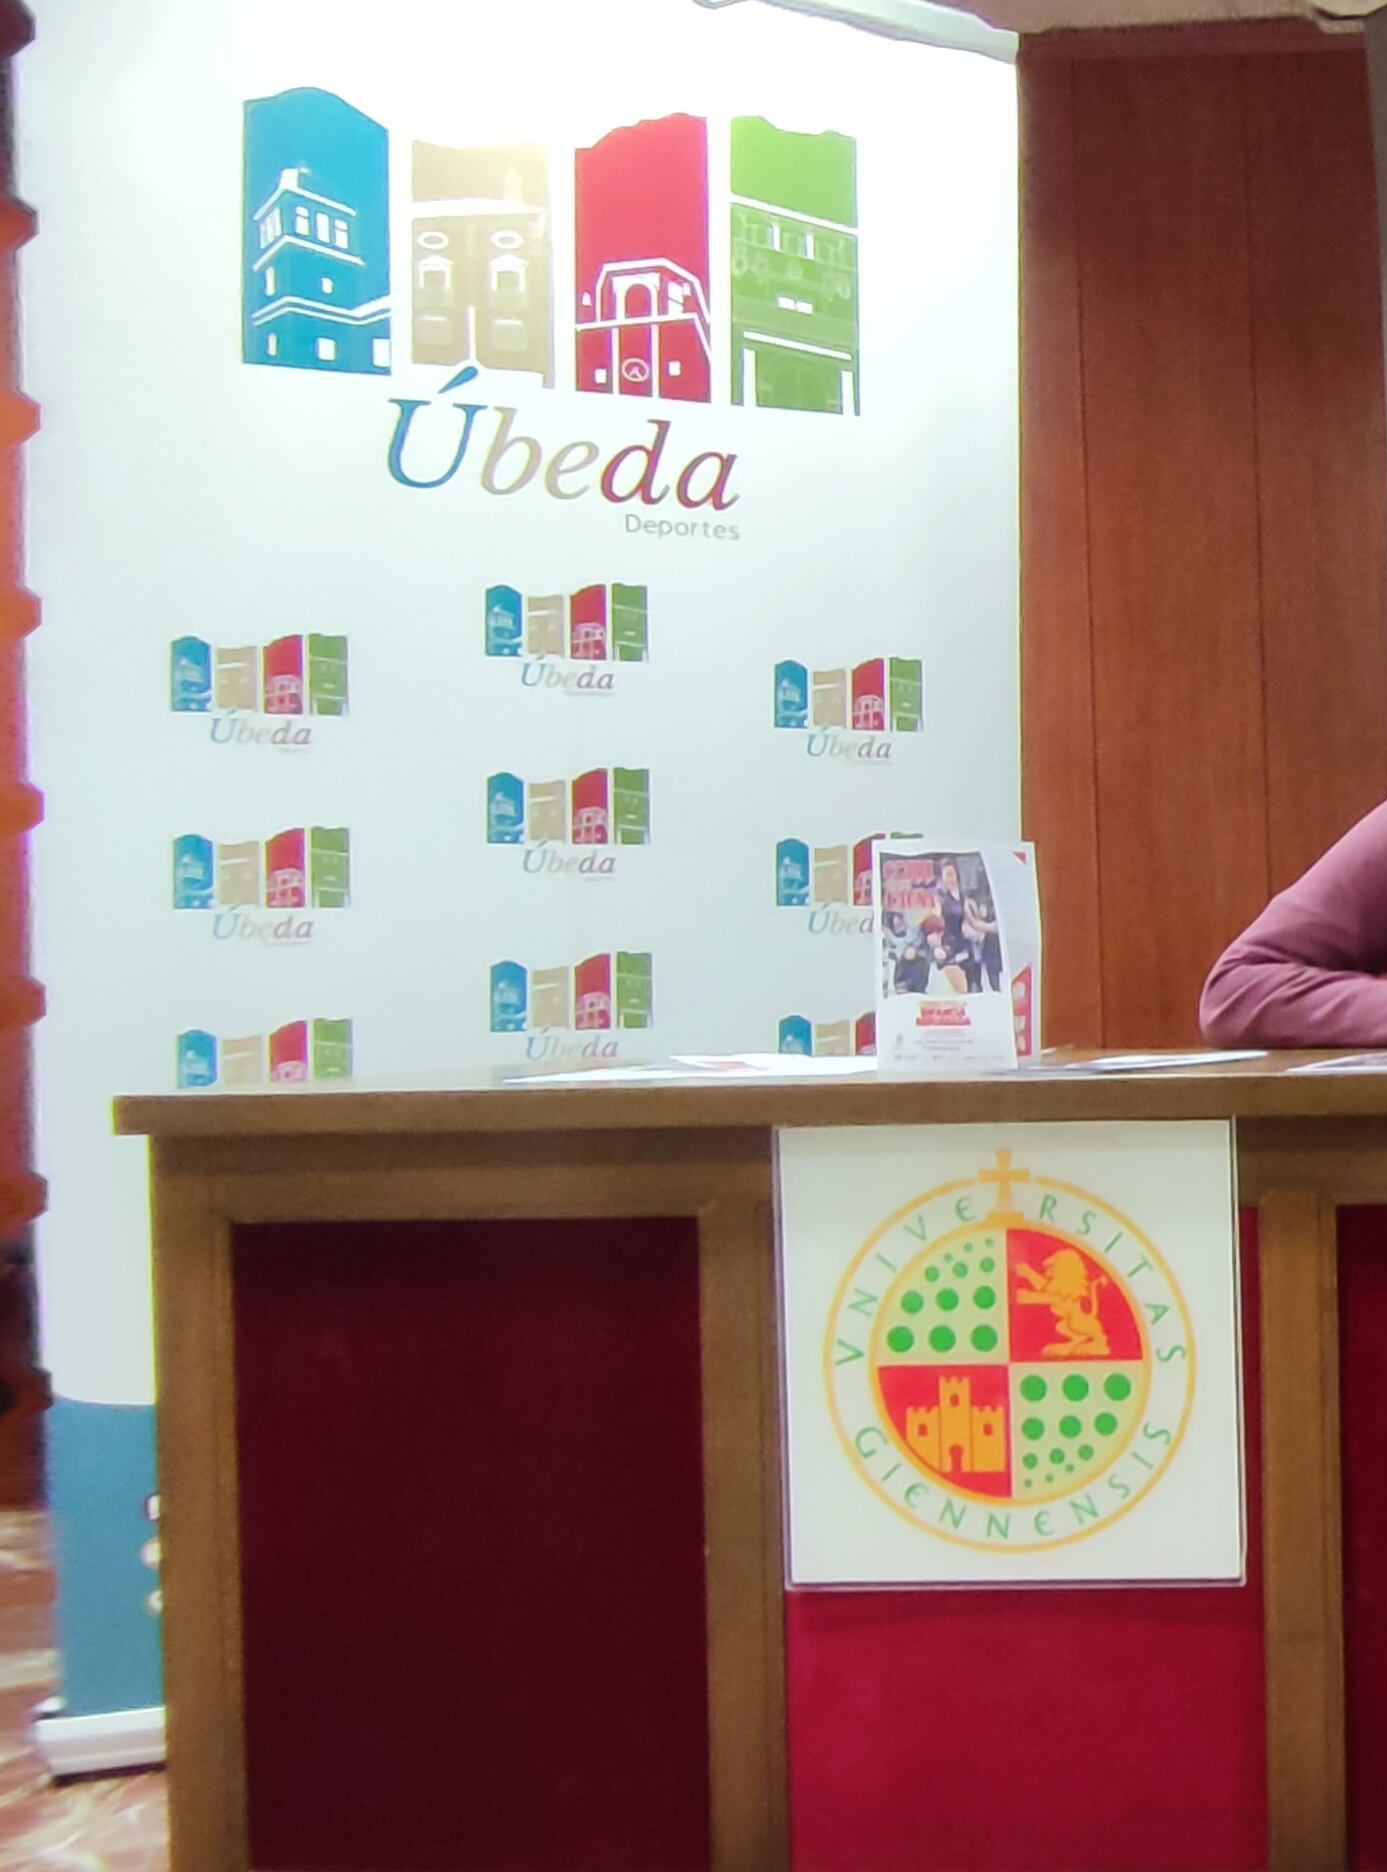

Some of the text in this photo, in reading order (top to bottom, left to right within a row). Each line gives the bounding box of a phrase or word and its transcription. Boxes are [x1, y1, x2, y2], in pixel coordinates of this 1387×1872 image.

[387, 366, 741, 511] Úbeda
[624, 513, 741, 541] Deportes
[520, 655, 615, 690] Úbeda
[210, 709, 313, 745] Úbeda
[806, 726, 892, 759] Úbeda
[522, 840, 616, 874] Úbeda
[211, 904, 315, 940] Úbeda
[526, 1028, 619, 1060] Úbeda
